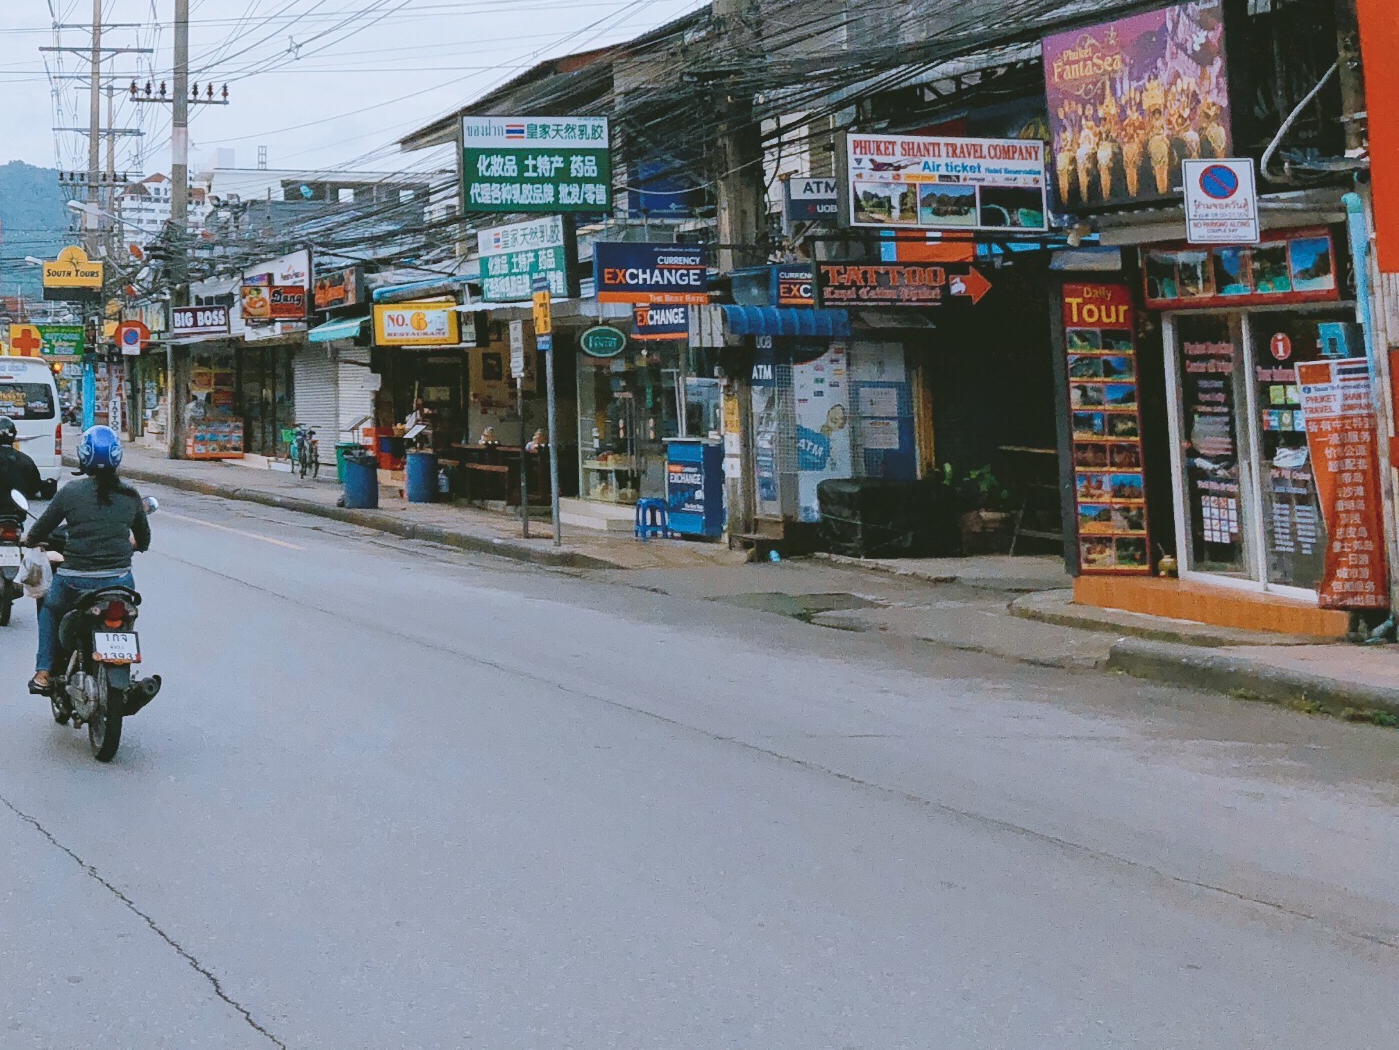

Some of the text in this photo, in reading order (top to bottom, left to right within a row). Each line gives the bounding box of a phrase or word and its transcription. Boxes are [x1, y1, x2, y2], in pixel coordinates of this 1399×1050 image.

[1063, 47, 1093, 62] Phuket
[526, 123, 604, 140] 皇家天然乳胶
[852, 139, 1040, 161] PHUKET SHANTI TRAVEL COMPANY
[523, 156, 564, 177] 土特产
[570, 156, 598, 177] 药品
[922, 160, 941, 173] Air
[945, 161, 982, 174] ticket
[803, 181, 837, 194] ATM
[816, 205, 838, 213] UOB
[657, 256, 701, 265] CURRENCY
[603, 268, 701, 285] EXCHANGE
[821, 265, 946, 287] TATTOO
[271, 287, 304, 305] Dang
[649, 293, 663, 302] THE
[665, 294, 683, 302] BEST
[1083, 286, 1112, 301] Daily
[636, 307, 686, 326] EXCHANGE
[1065, 297, 1129, 323] Tour
[173, 310, 226, 327] BIG BOSS
[386, 314, 408, 327] NO.
[752, 365, 772, 380] ATM
[1305, 394, 1336, 404] PHUKET
[111, 400, 119, 431] TATTOO
[1303, 406, 1336, 414] TRAVEL
[797, 438, 824, 457] ATM
